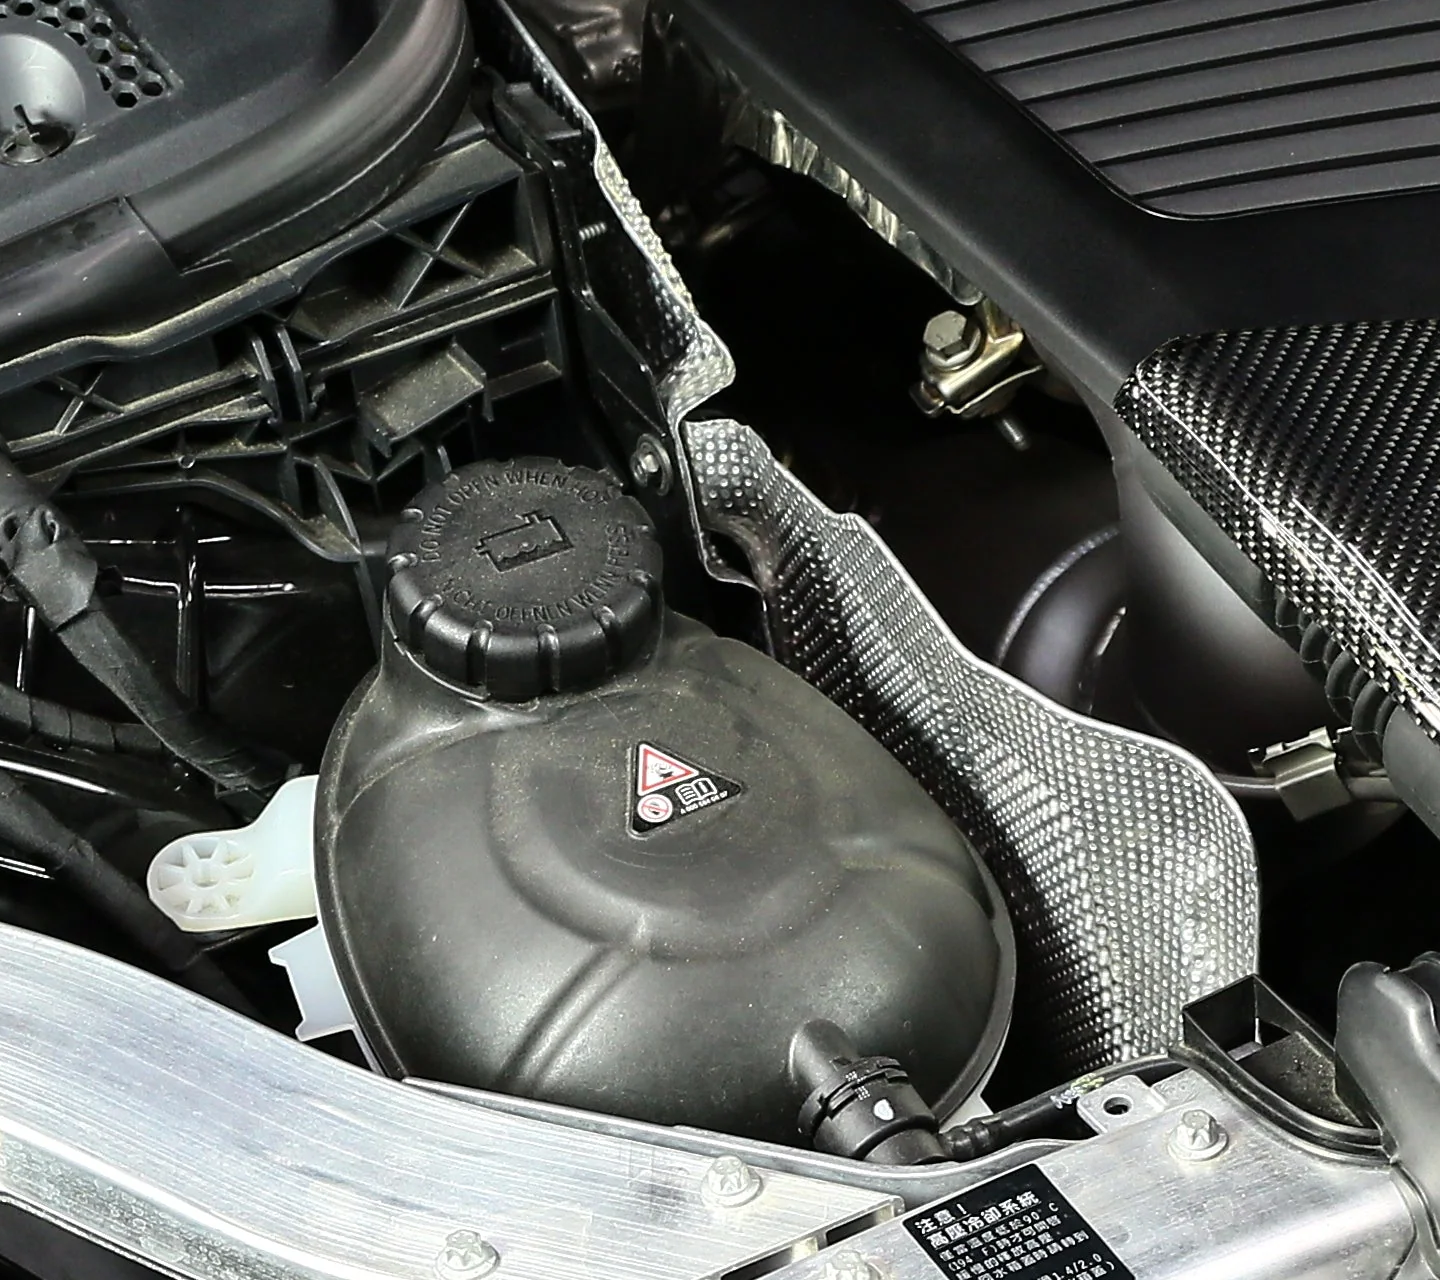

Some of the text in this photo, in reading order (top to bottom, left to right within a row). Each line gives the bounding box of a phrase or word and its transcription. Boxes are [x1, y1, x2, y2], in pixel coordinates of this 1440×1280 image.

[418, 467, 609, 563] DO NOT OPEN WHEN HOT
